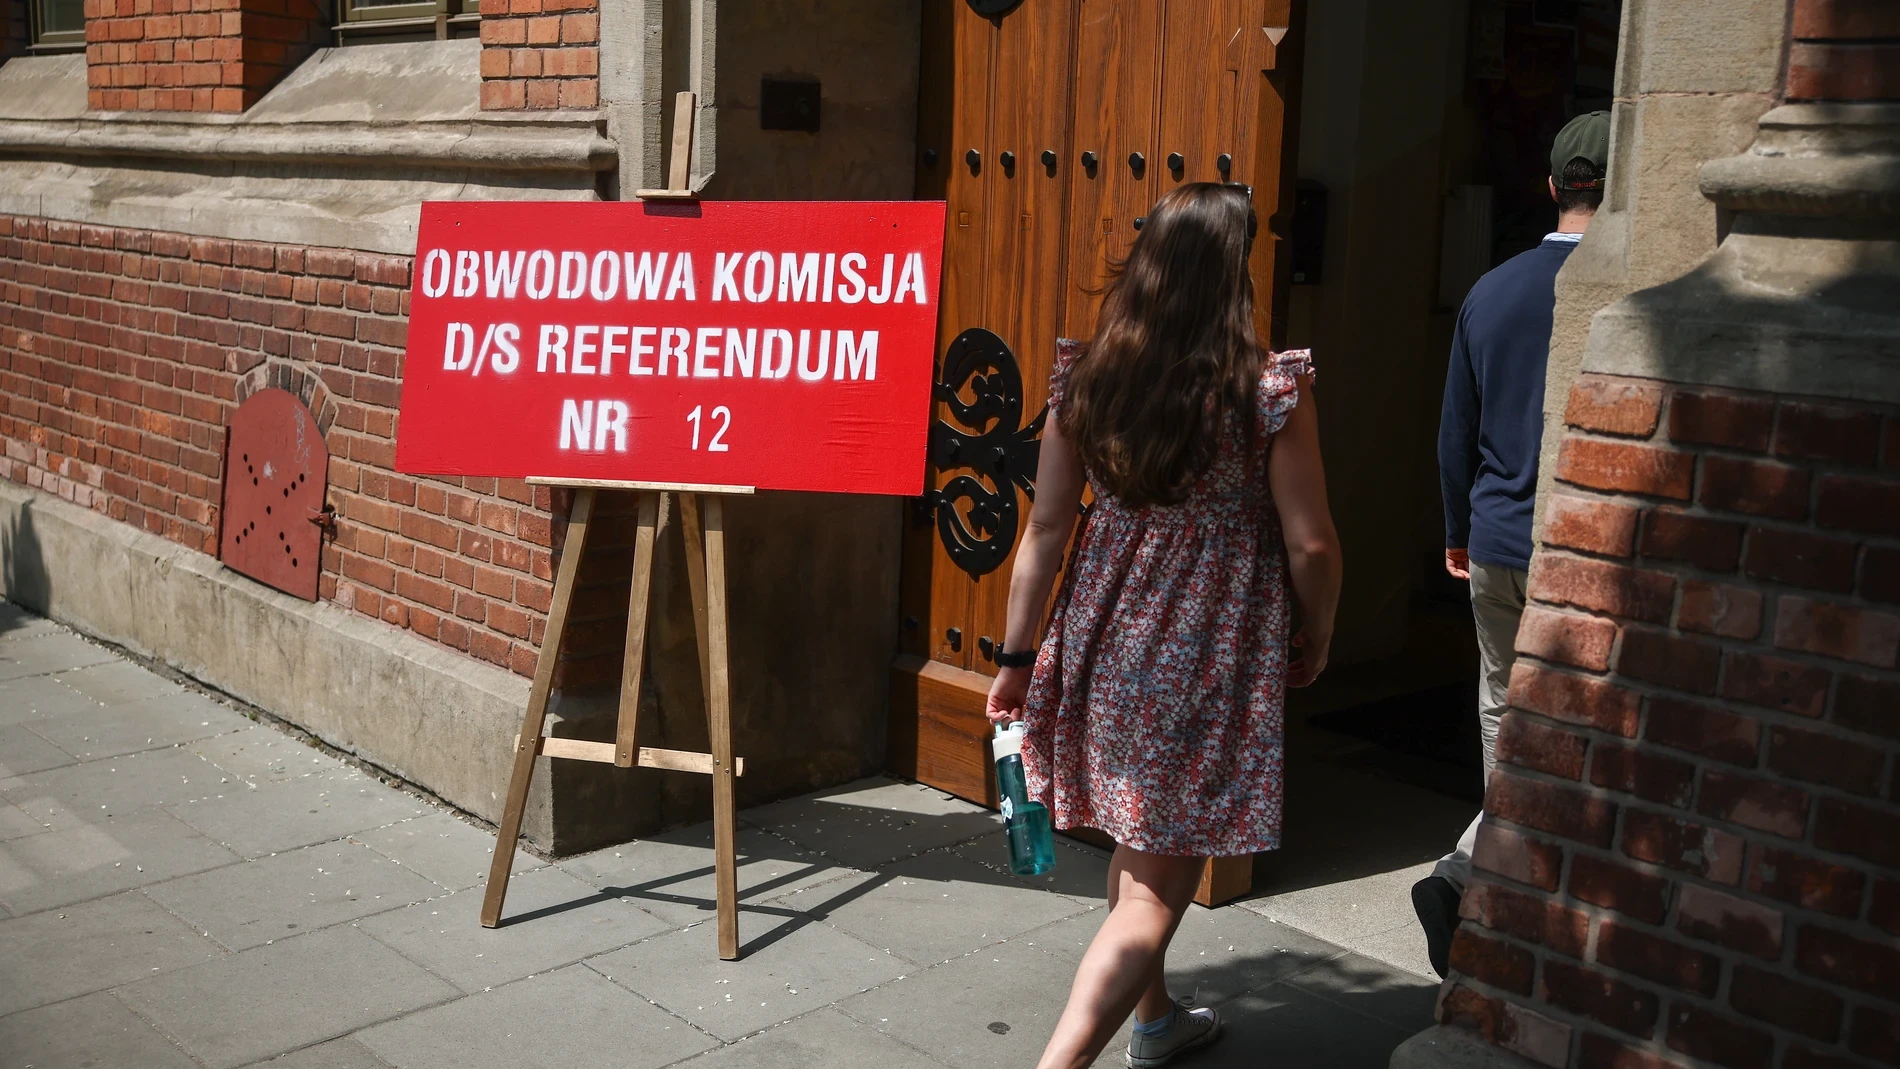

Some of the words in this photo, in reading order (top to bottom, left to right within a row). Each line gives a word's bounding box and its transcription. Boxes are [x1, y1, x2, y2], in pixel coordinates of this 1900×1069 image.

[422, 248, 696, 301] OBWODOWA
[711, 250, 928, 305] KOMISJA
[443, 321, 521, 377] D/S
[536, 324, 879, 381] REFERENDUM
[558, 398, 631, 453] NR
[686, 404, 732, 453] 12
